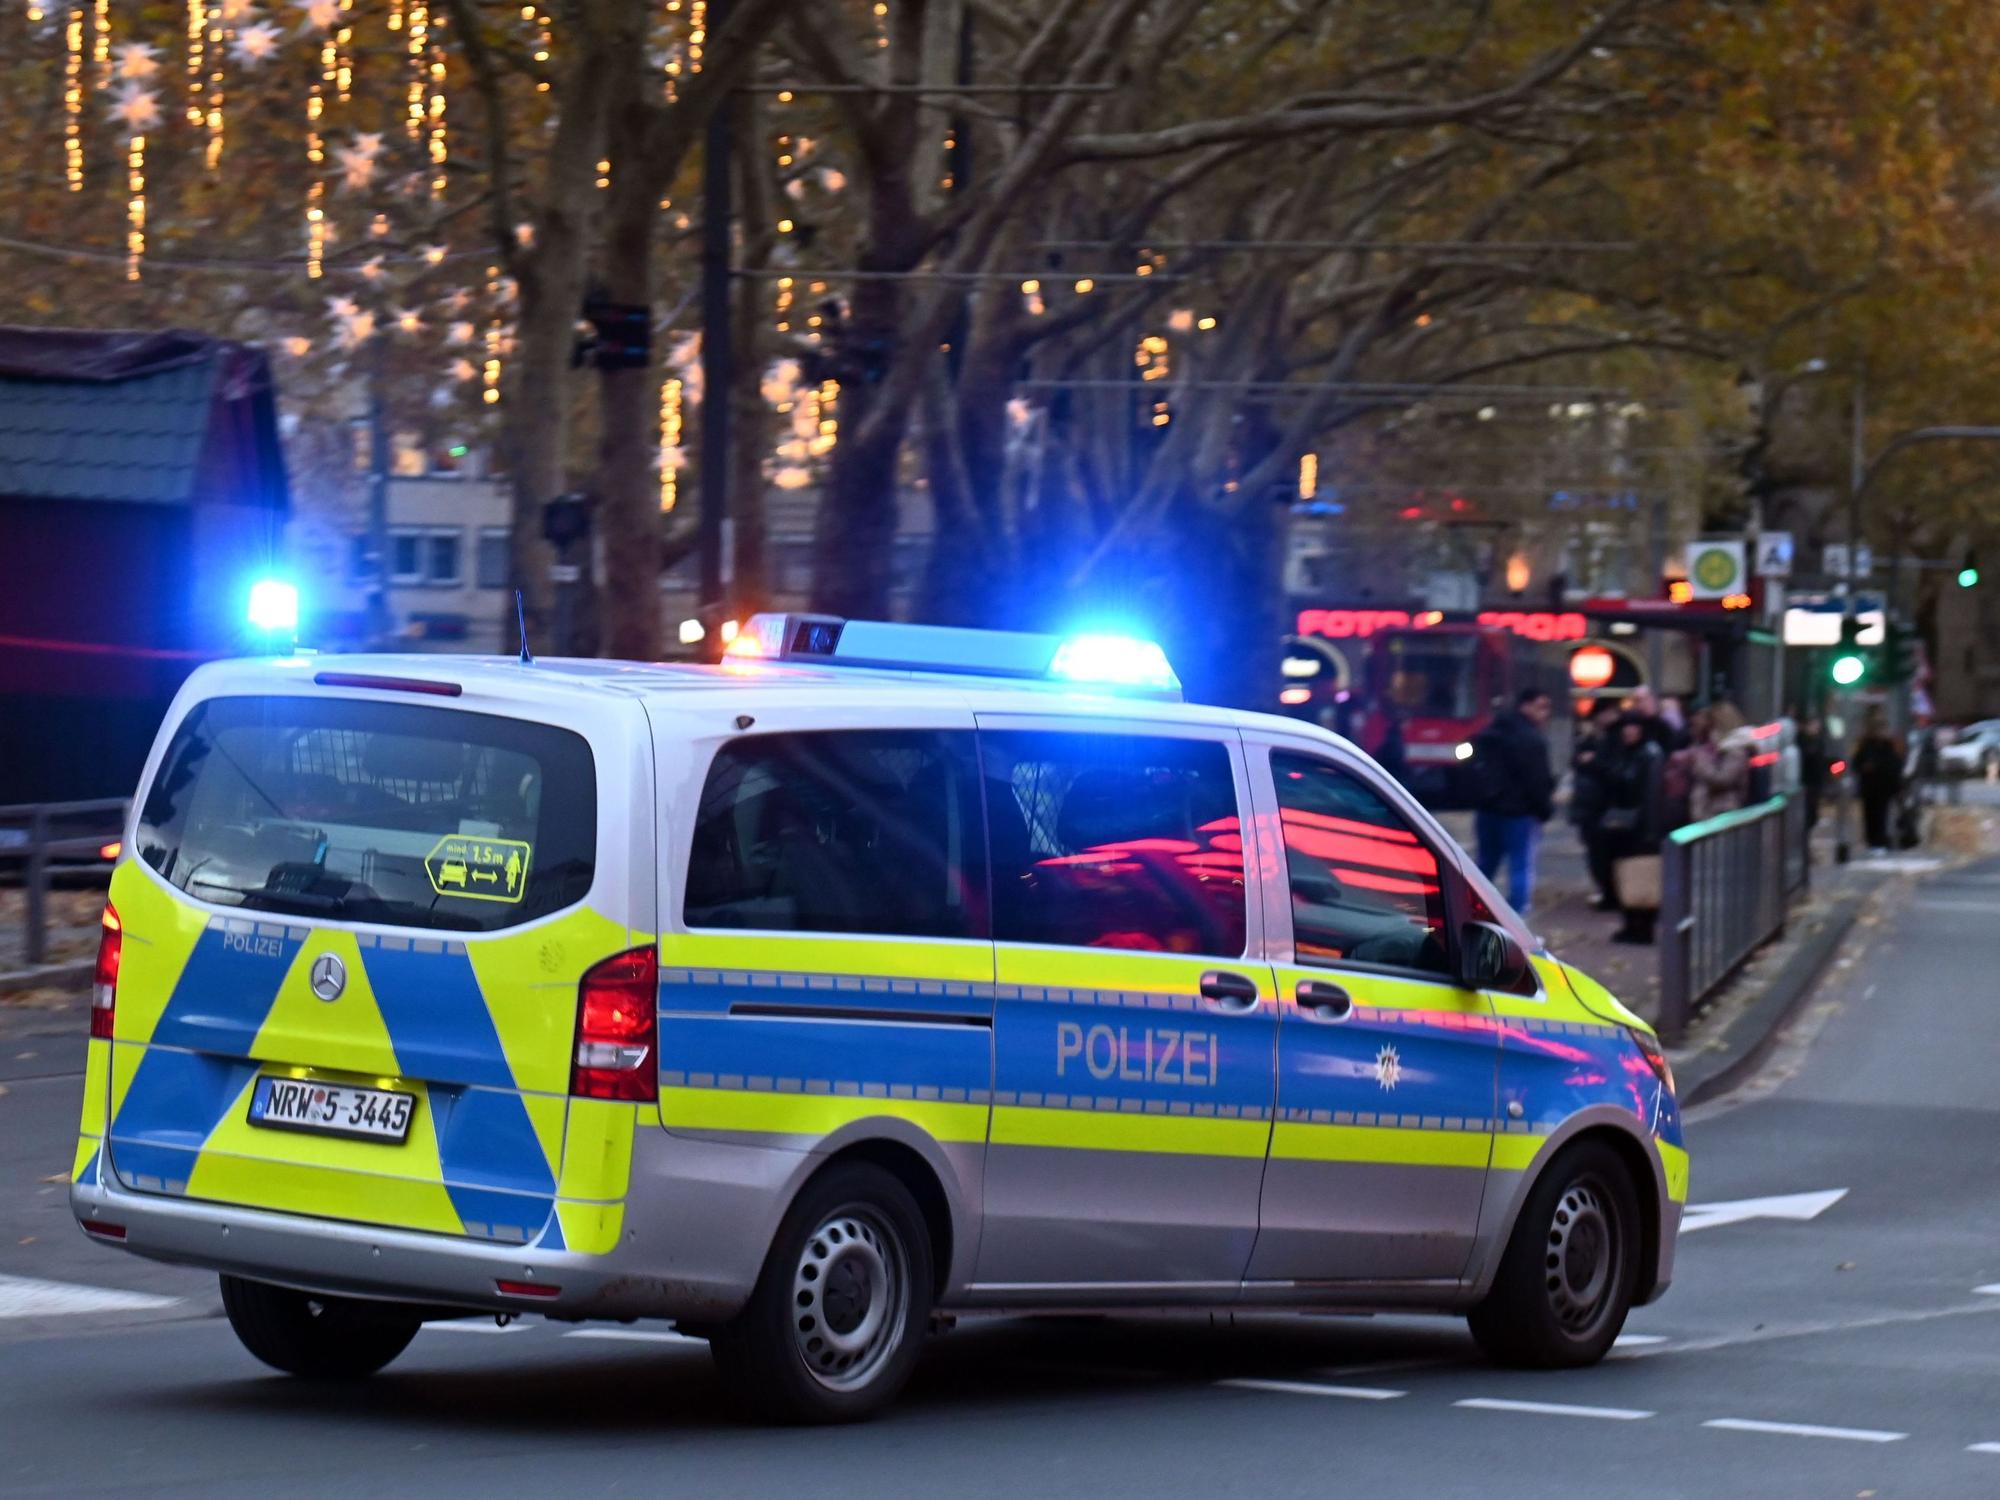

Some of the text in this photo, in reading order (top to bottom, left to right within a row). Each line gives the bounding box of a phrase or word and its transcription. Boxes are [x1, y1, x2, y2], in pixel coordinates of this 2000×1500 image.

[224, 932, 283, 957] POLIZEI
[1057, 1021, 1217, 1087] POLIZEI
[266, 1084, 314, 1119] NRW
